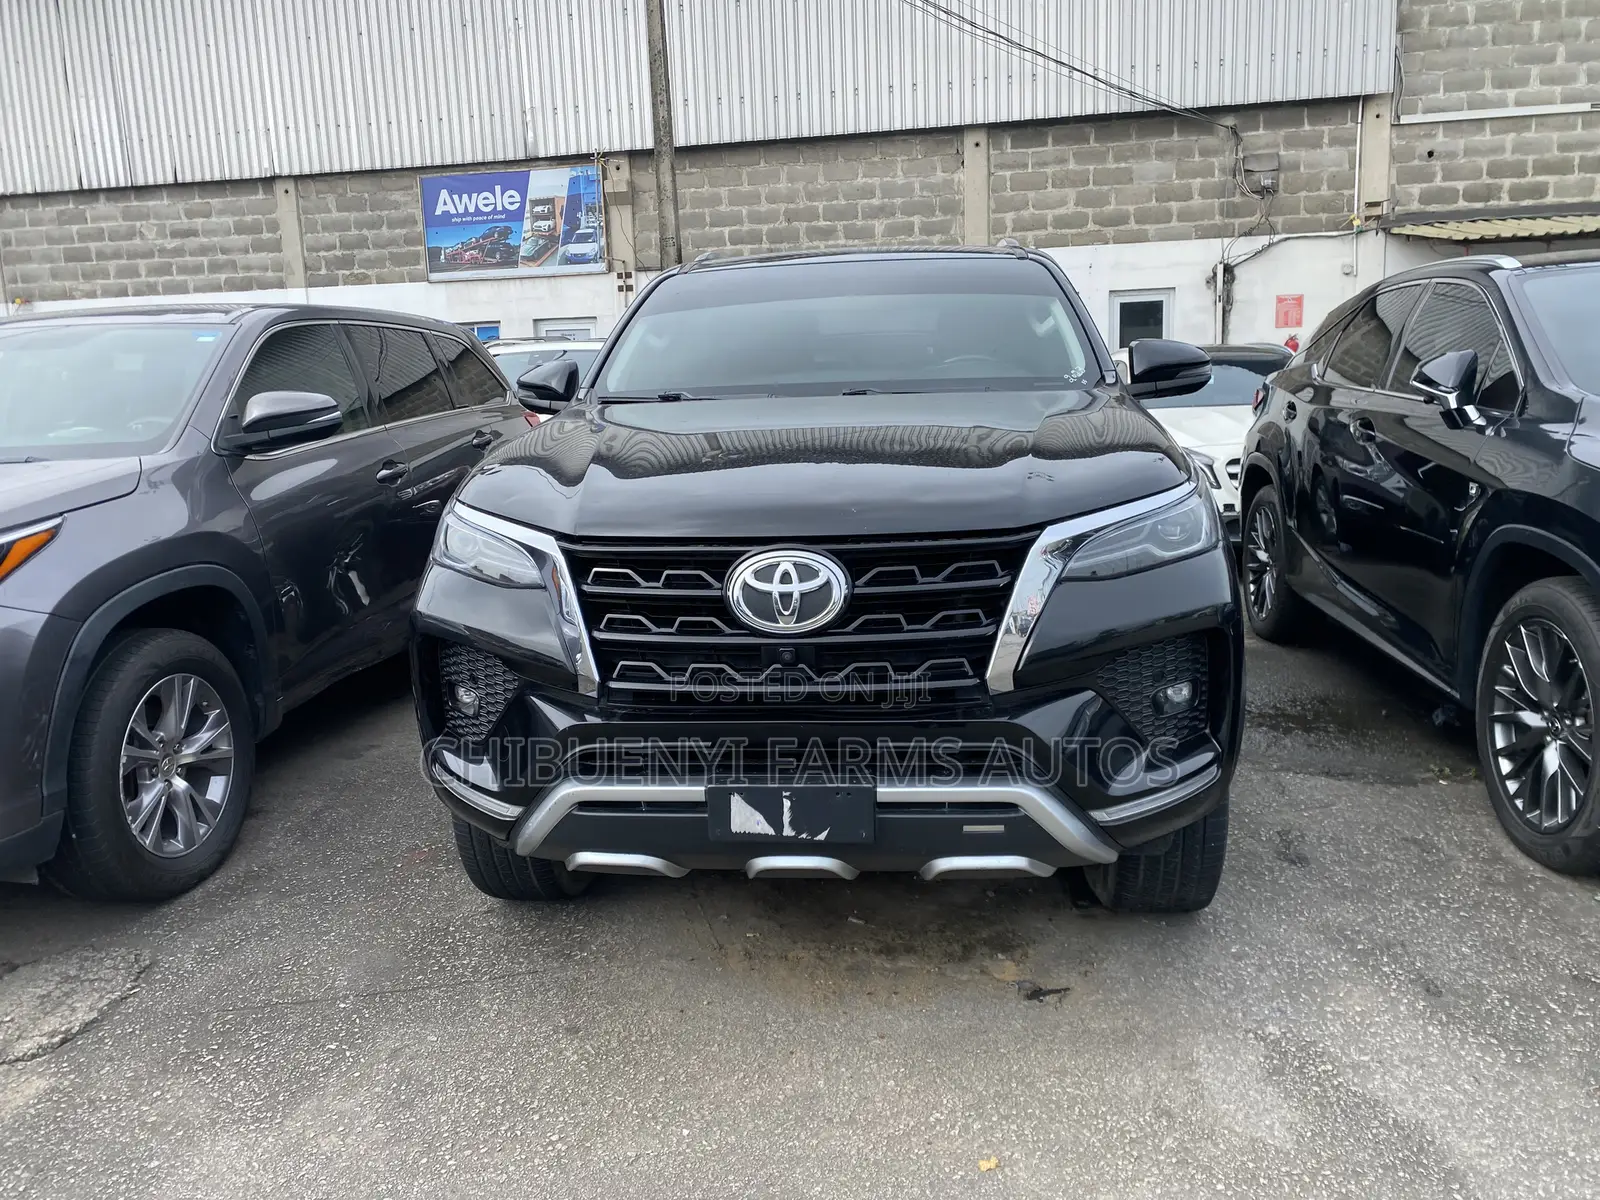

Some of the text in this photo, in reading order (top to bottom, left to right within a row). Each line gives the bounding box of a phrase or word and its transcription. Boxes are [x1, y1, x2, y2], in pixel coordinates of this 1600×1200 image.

[434, 185, 521, 215] Awele
[451, 215, 462, 223] ship
[473, 214, 487, 222] peace
